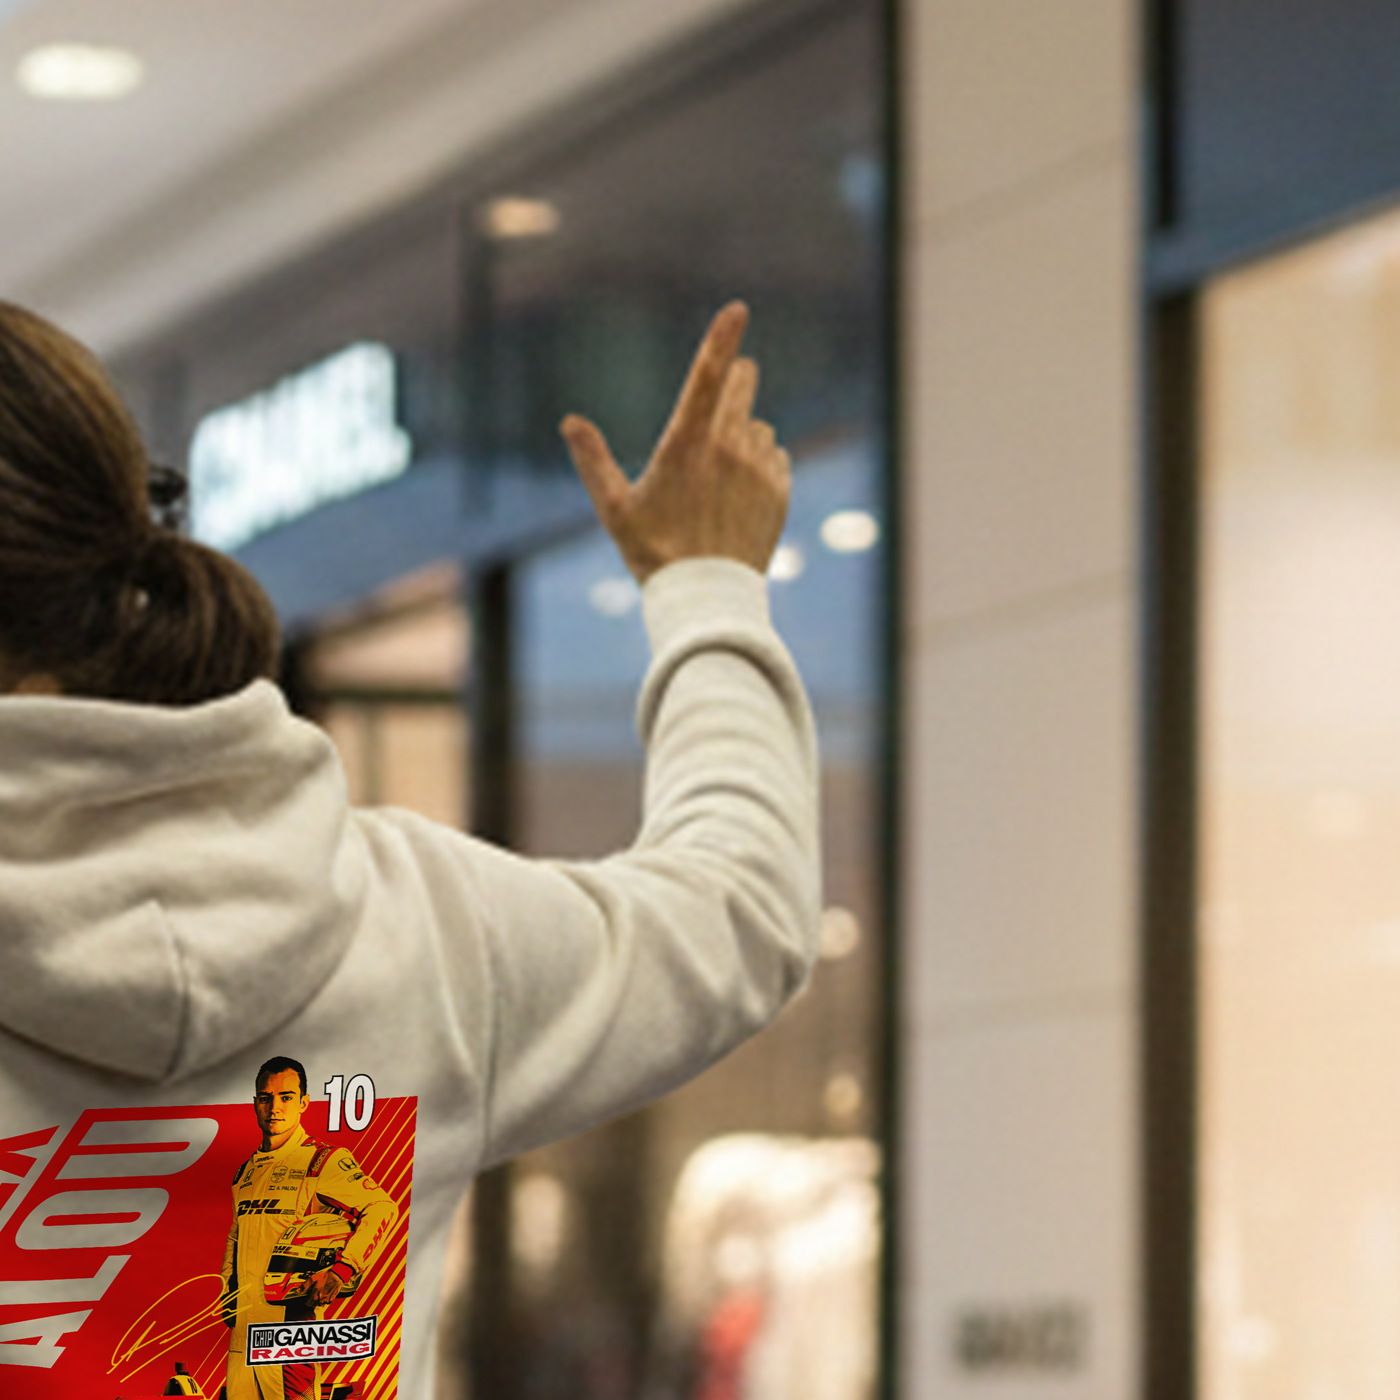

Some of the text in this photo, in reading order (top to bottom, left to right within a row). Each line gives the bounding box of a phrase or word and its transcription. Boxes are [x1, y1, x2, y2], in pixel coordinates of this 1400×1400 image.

[324, 1073, 376, 1133] 10
[362, 1217, 391, 1264] DHL
[251, 1342, 371, 1360] RACING
[254, 1322, 372, 1347] CHIP GANASSI
